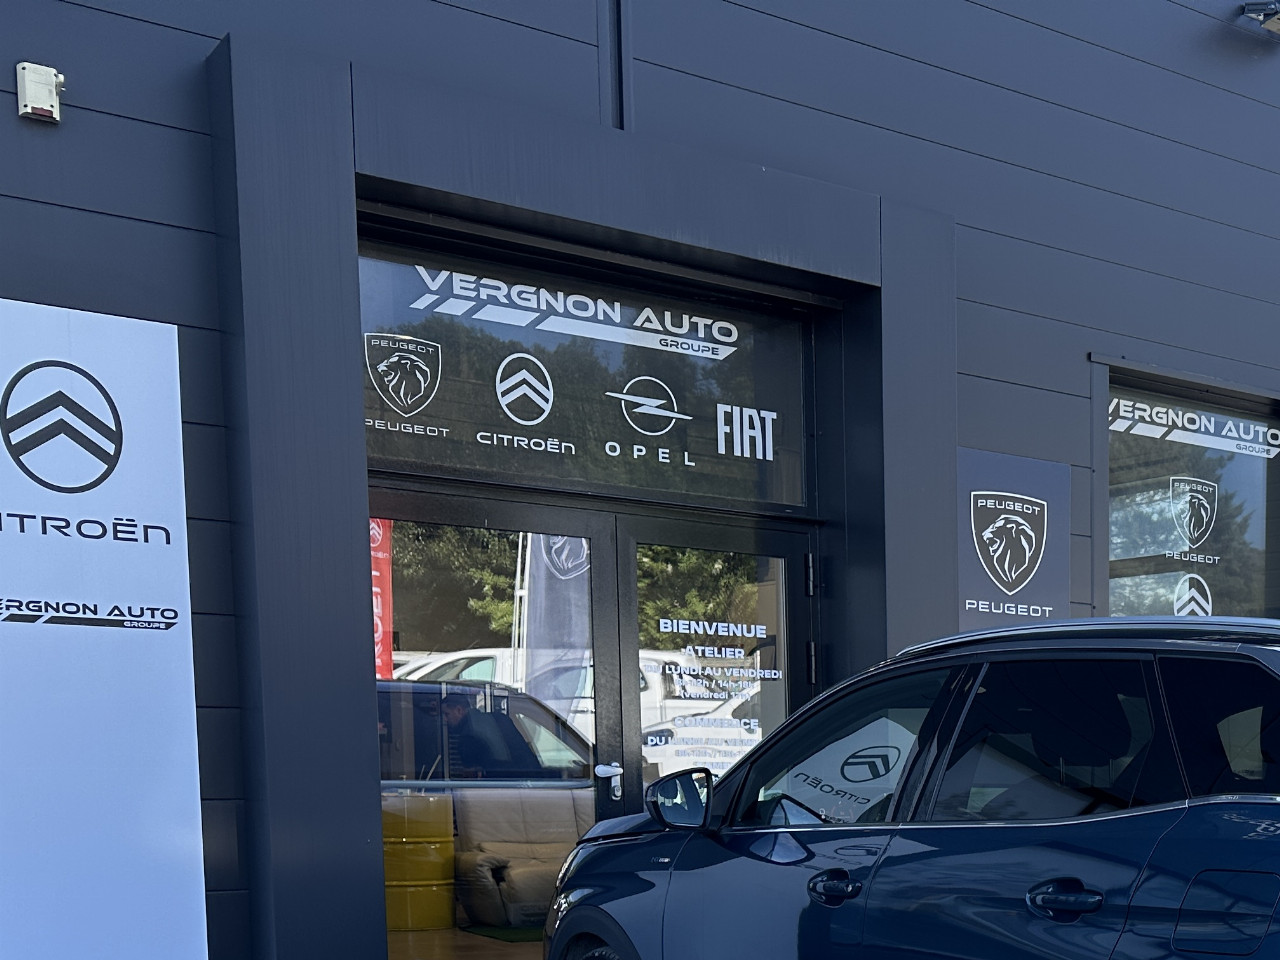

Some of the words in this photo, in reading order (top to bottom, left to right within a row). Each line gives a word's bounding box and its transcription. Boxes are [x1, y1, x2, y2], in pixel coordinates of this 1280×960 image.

[414, 265, 621, 323] VERGNON
[633, 307, 739, 343] AUTO
[371, 339, 435, 355] PEUGEOT
[659, 338, 720, 356] GROUPE
[716, 403, 777, 461] FIAT
[476, 431, 576, 455] CITROËN
[1236, 443, 1272, 456] GROUPE
[605, 441, 696, 467] OPEL
[1174, 482, 1214, 493] PEUGEOT
[977, 499, 1041, 516] PEUGEOT
[1165, 550, 1221, 566] PEUGEOT
[0, 599, 98, 615] RGNON
[106, 605, 178, 620] AUTO
[965, 599, 1053, 618] PEUGEOT
[124, 621, 166, 629] GROUPE
[659, 618, 767, 639] BIENVENUE
[685, 645, 745, 659] ATELIER
[666, 665, 702, 676] LUNDI
[704, 667, 721, 677] AU
[724, 668, 783, 679] VENDREDI
[680, 690, 728, 700] (vendredi
[648, 736, 665, 746] DU
